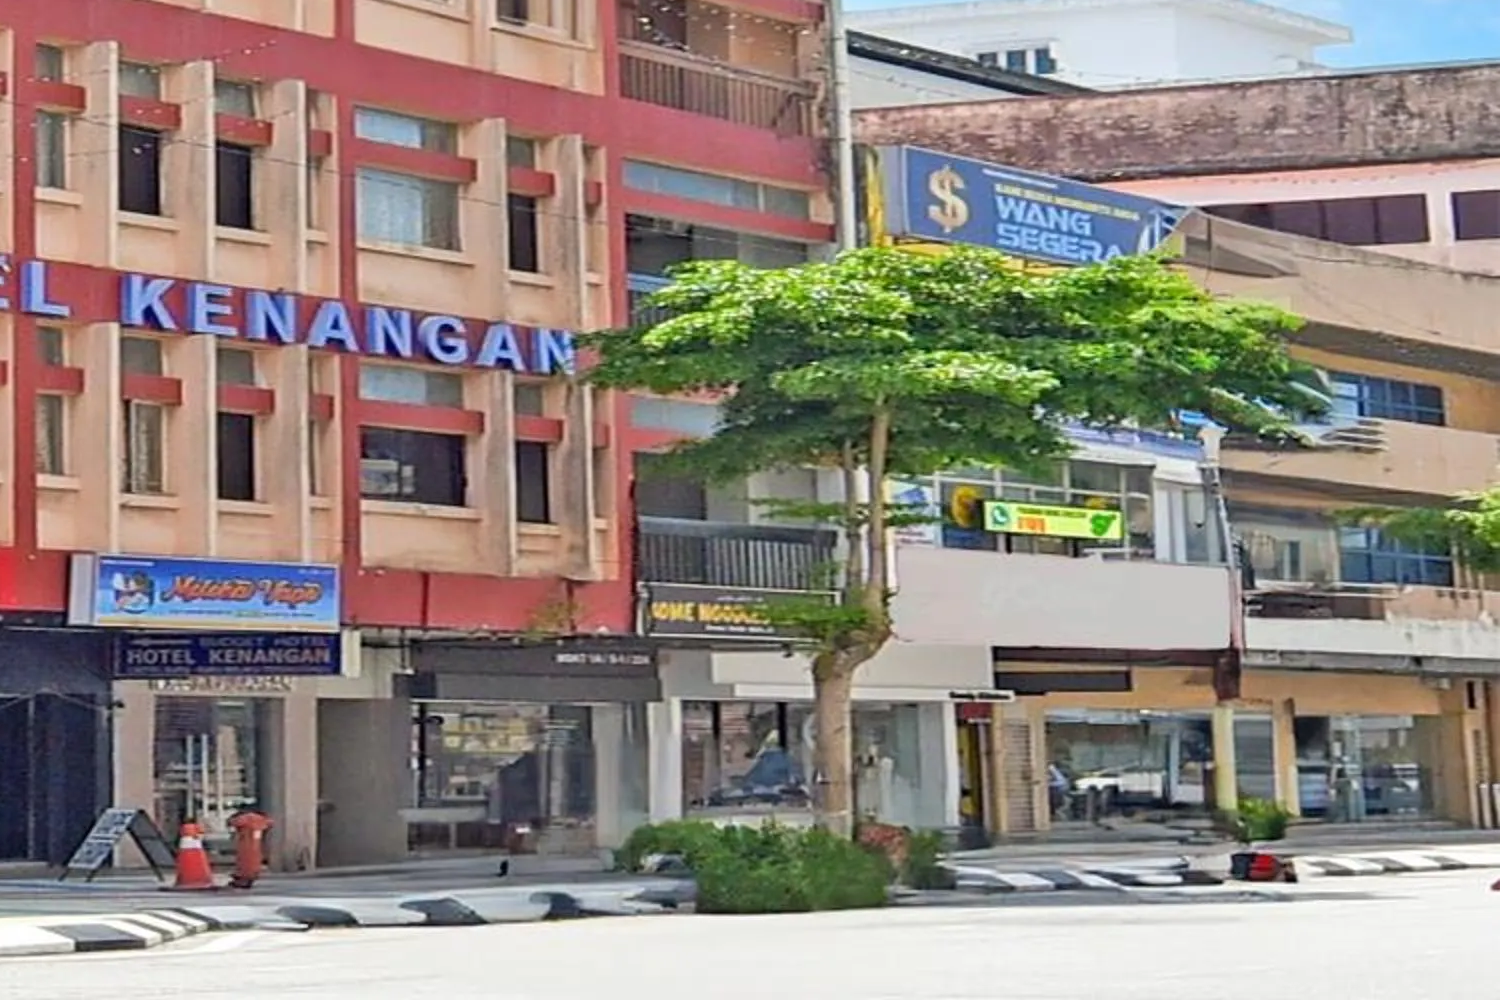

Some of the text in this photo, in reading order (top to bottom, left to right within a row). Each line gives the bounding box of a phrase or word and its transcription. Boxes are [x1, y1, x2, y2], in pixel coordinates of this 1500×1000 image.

[995, 195, 1092, 236] WANG
[996, 222, 1124, 263] SEGERA
[120, 272, 576, 375] KENANGAN
[127, 649, 330, 665] HOTEL KENANGAN
